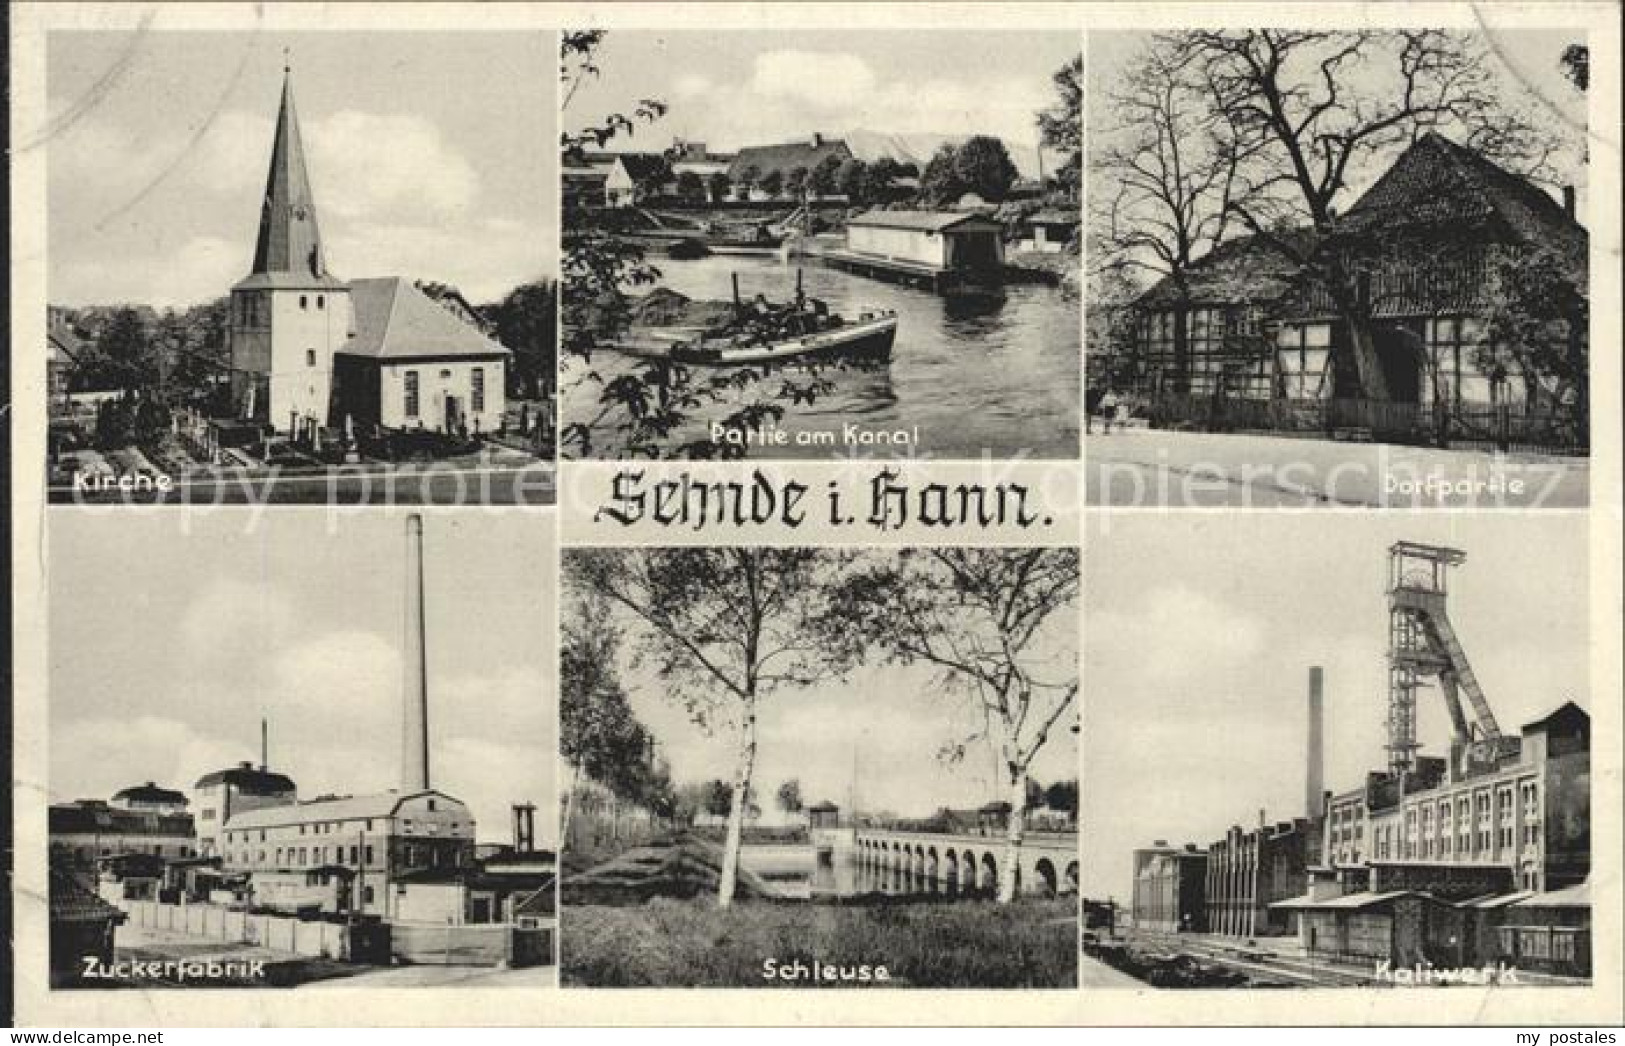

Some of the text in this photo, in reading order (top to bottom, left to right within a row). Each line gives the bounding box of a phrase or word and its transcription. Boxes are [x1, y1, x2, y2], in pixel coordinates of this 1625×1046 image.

[594, 465, 1054, 532] Sehnde i. Hann.
